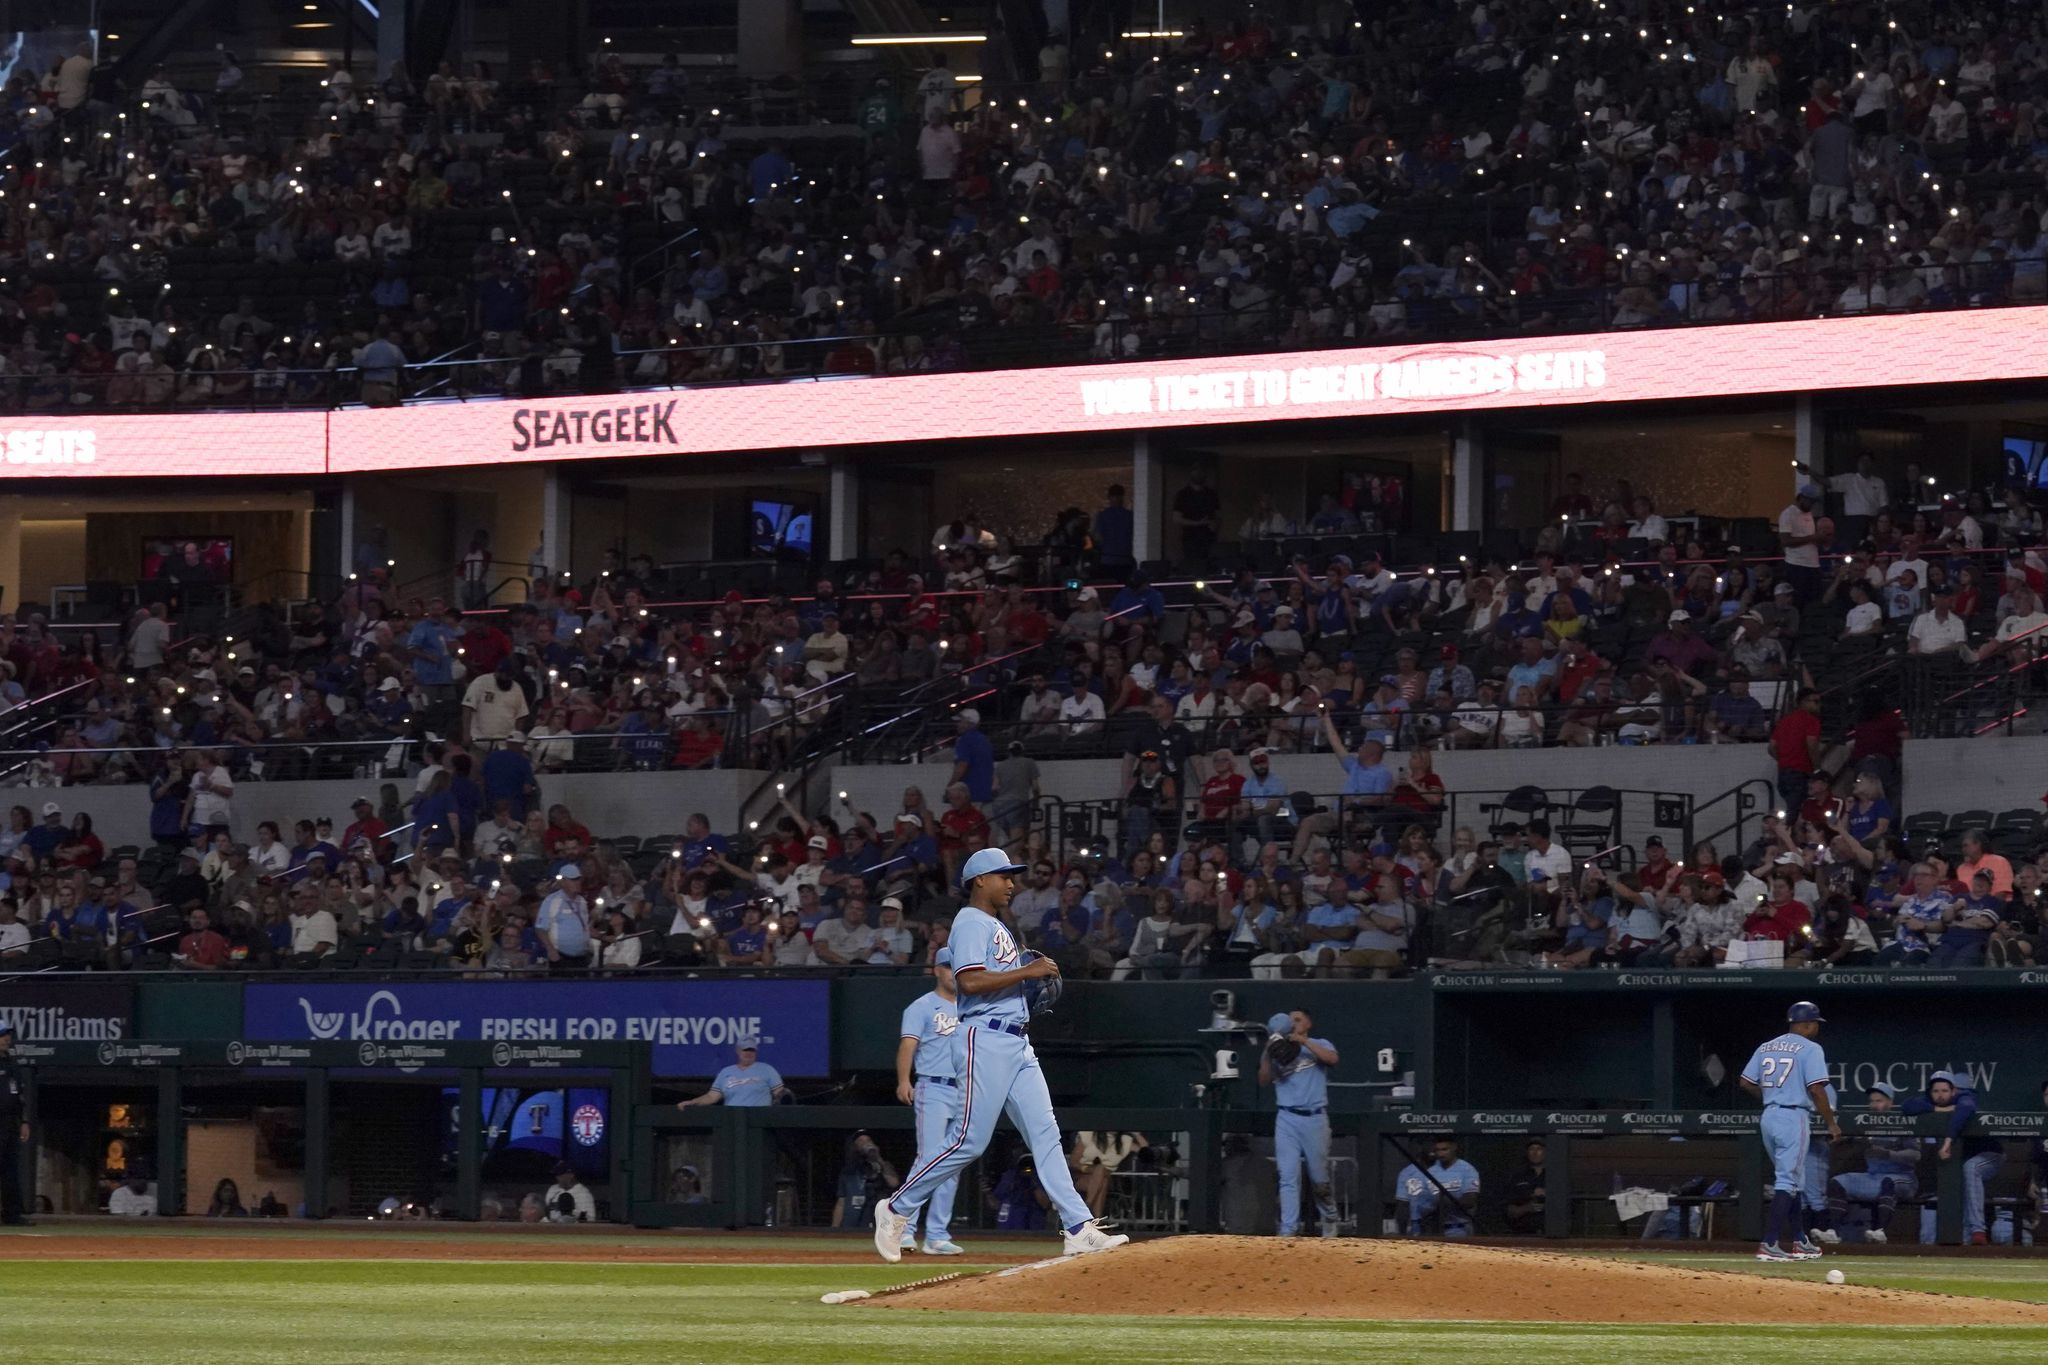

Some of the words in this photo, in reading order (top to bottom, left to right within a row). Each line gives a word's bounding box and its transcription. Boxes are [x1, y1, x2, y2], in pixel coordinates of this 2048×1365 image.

[1155, 372, 1248, 411] TICKET
[1248, 370, 1287, 407] TO
[1290, 364, 1378, 404] GREAT
[1517, 350, 1606, 390] SEATS
[512, 400, 678, 452] SEATGEEK
[6, 430, 96, 464] SEATS
[1436, 974, 1495, 986] CHOCTAW
[1622, 973, 1682, 985] CHOCTAW
[1822, 972, 1884, 985] CHOCTAW
[0, 1006, 122, 1040] Williams
[481, 1018, 557, 1040] FRESH
[566, 1017, 617, 1040] FOR
[626, 1016, 761, 1045] EVERYONE
[1760, 1040, 1805, 1054] BEASLEY
[1761, 1057, 1795, 1089] 27
[1404, 1113, 1460, 1124] CHOCTAW
[1478, 1113, 1533, 1124] CHOCTAW
[1552, 1113, 1608, 1124] CHOCTAW
[1627, 1112, 1684, 1124] CHOCTAW
[1704, 1113, 1760, 1124] CHOCTAW
[1861, 1113, 1917, 1125] CHOCTAW
[1986, 1114, 2045, 1126] CHOCTAW
